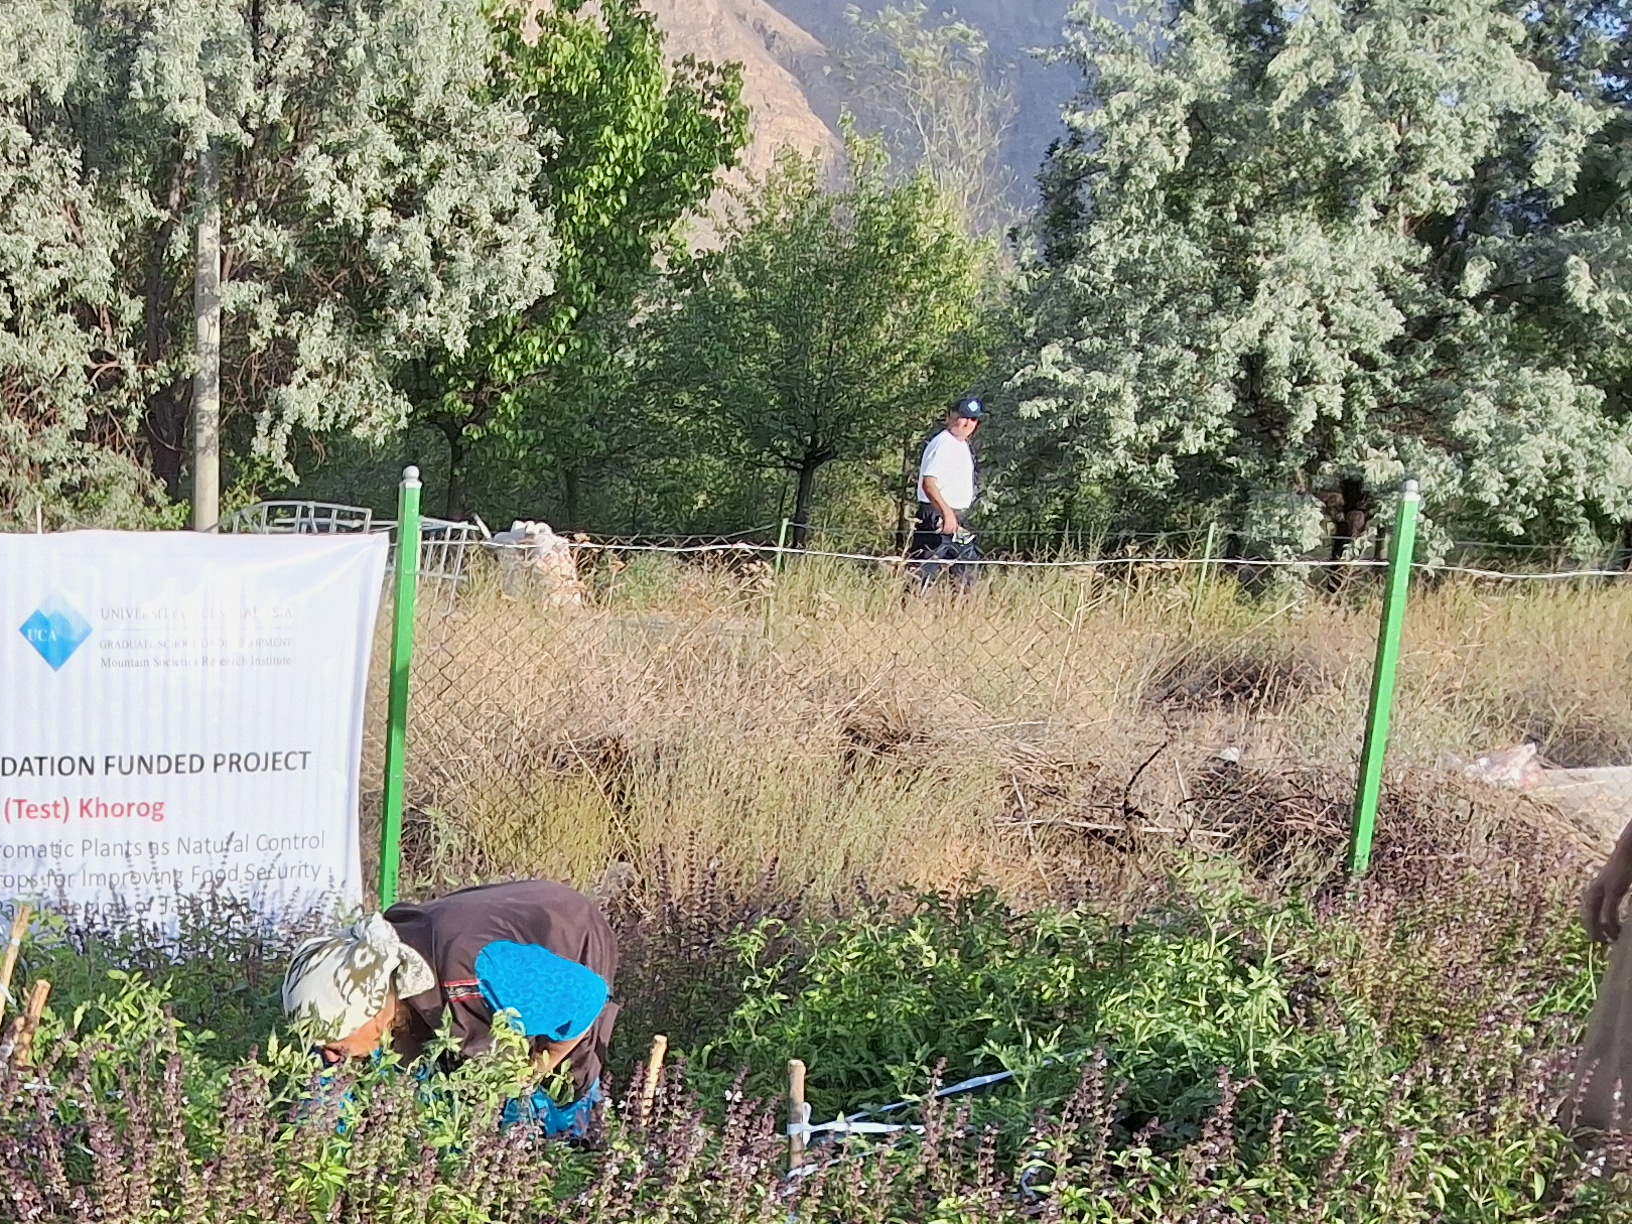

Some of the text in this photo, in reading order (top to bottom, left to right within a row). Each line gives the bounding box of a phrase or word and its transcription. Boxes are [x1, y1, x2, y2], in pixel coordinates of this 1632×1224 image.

[27, 628, 57, 642] UCA
[99, 639, 153, 650] GRADUAT
[100, 656, 150, 668] Mountain
[250, 654, 292, 667] Institute
[104, 753, 205, 776] FUNDED
[213, 750, 312, 773] PROJECT
[4, 796, 69, 824] (Test)
[79, 797, 165, 822] Khorog
[81, 837, 142, 858] Plants
[149, 841, 170, 856] as
[256, 830, 325, 852] Control
[46, 868, 74, 888] for
[192, 863, 238, 883] Food
[244, 860, 322, 882] Security
